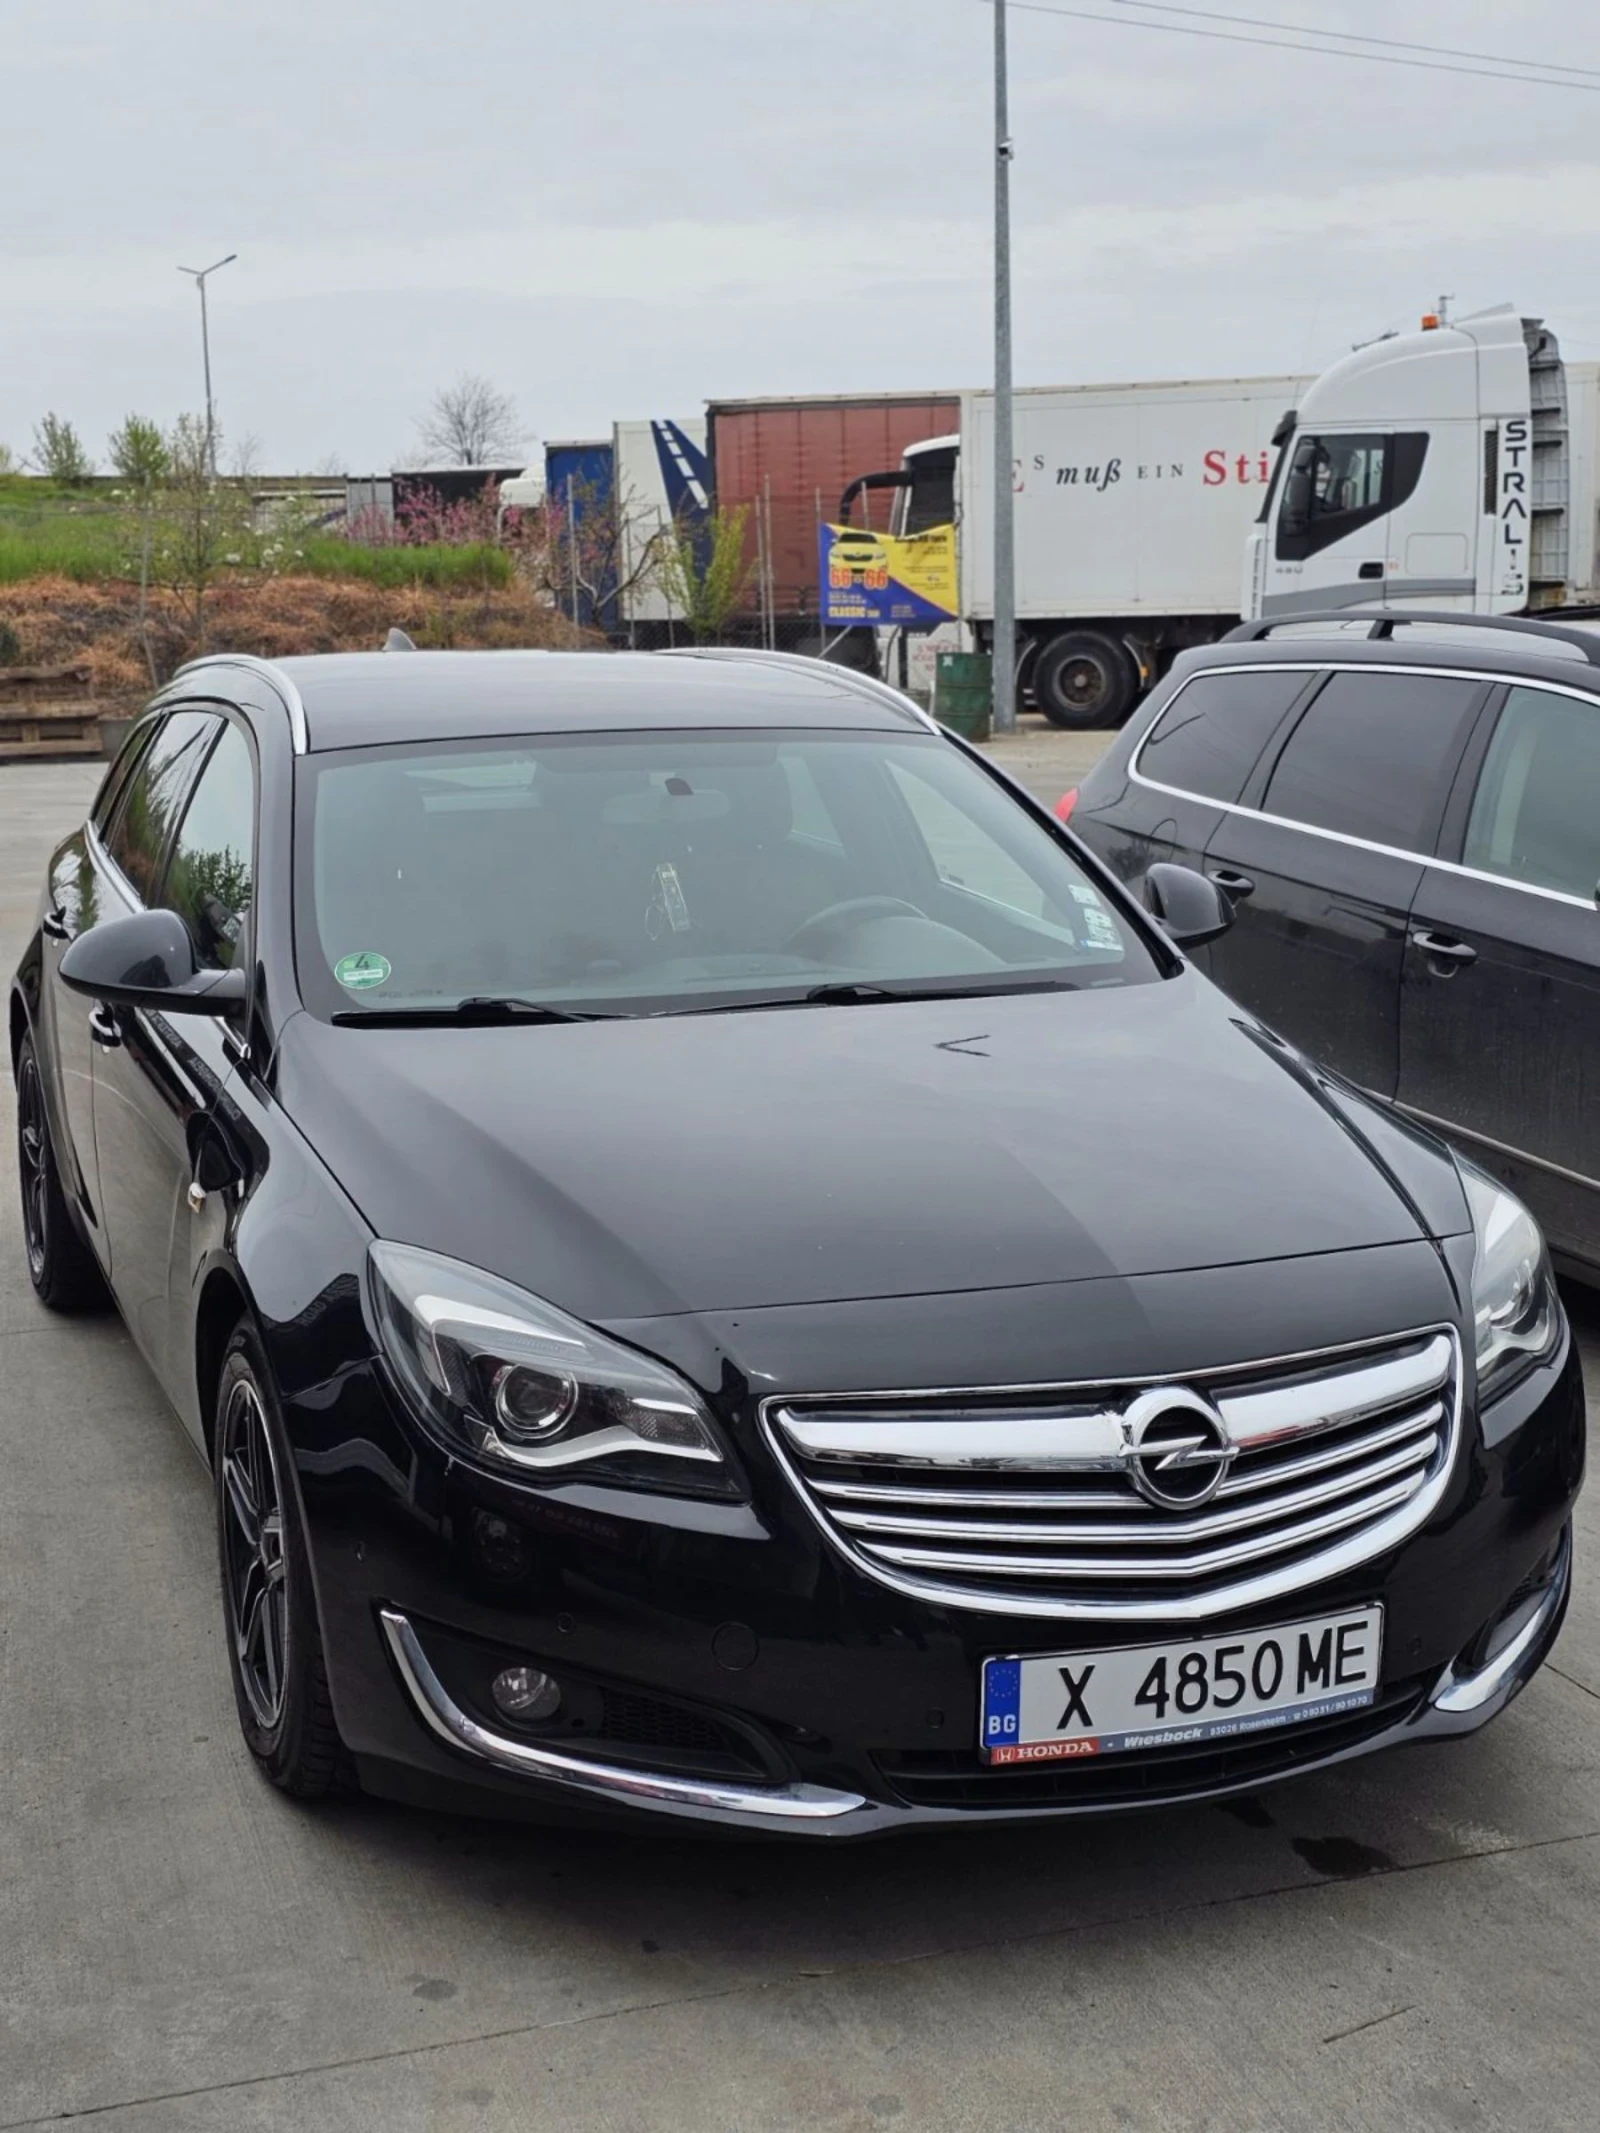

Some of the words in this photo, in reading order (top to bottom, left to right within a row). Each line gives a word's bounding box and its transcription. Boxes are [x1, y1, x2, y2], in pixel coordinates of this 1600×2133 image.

[1056, 458, 1122, 491] muß
[1137, 464, 1184, 479] EIN
[1057, 1665, 1095, 1730] X
[1135, 1639, 1284, 1719] 4850
[1297, 1620, 1369, 1694] ME
[988, 1714, 1016, 1735] BG
[1017, 1742, 1094, 1759] HONDA
